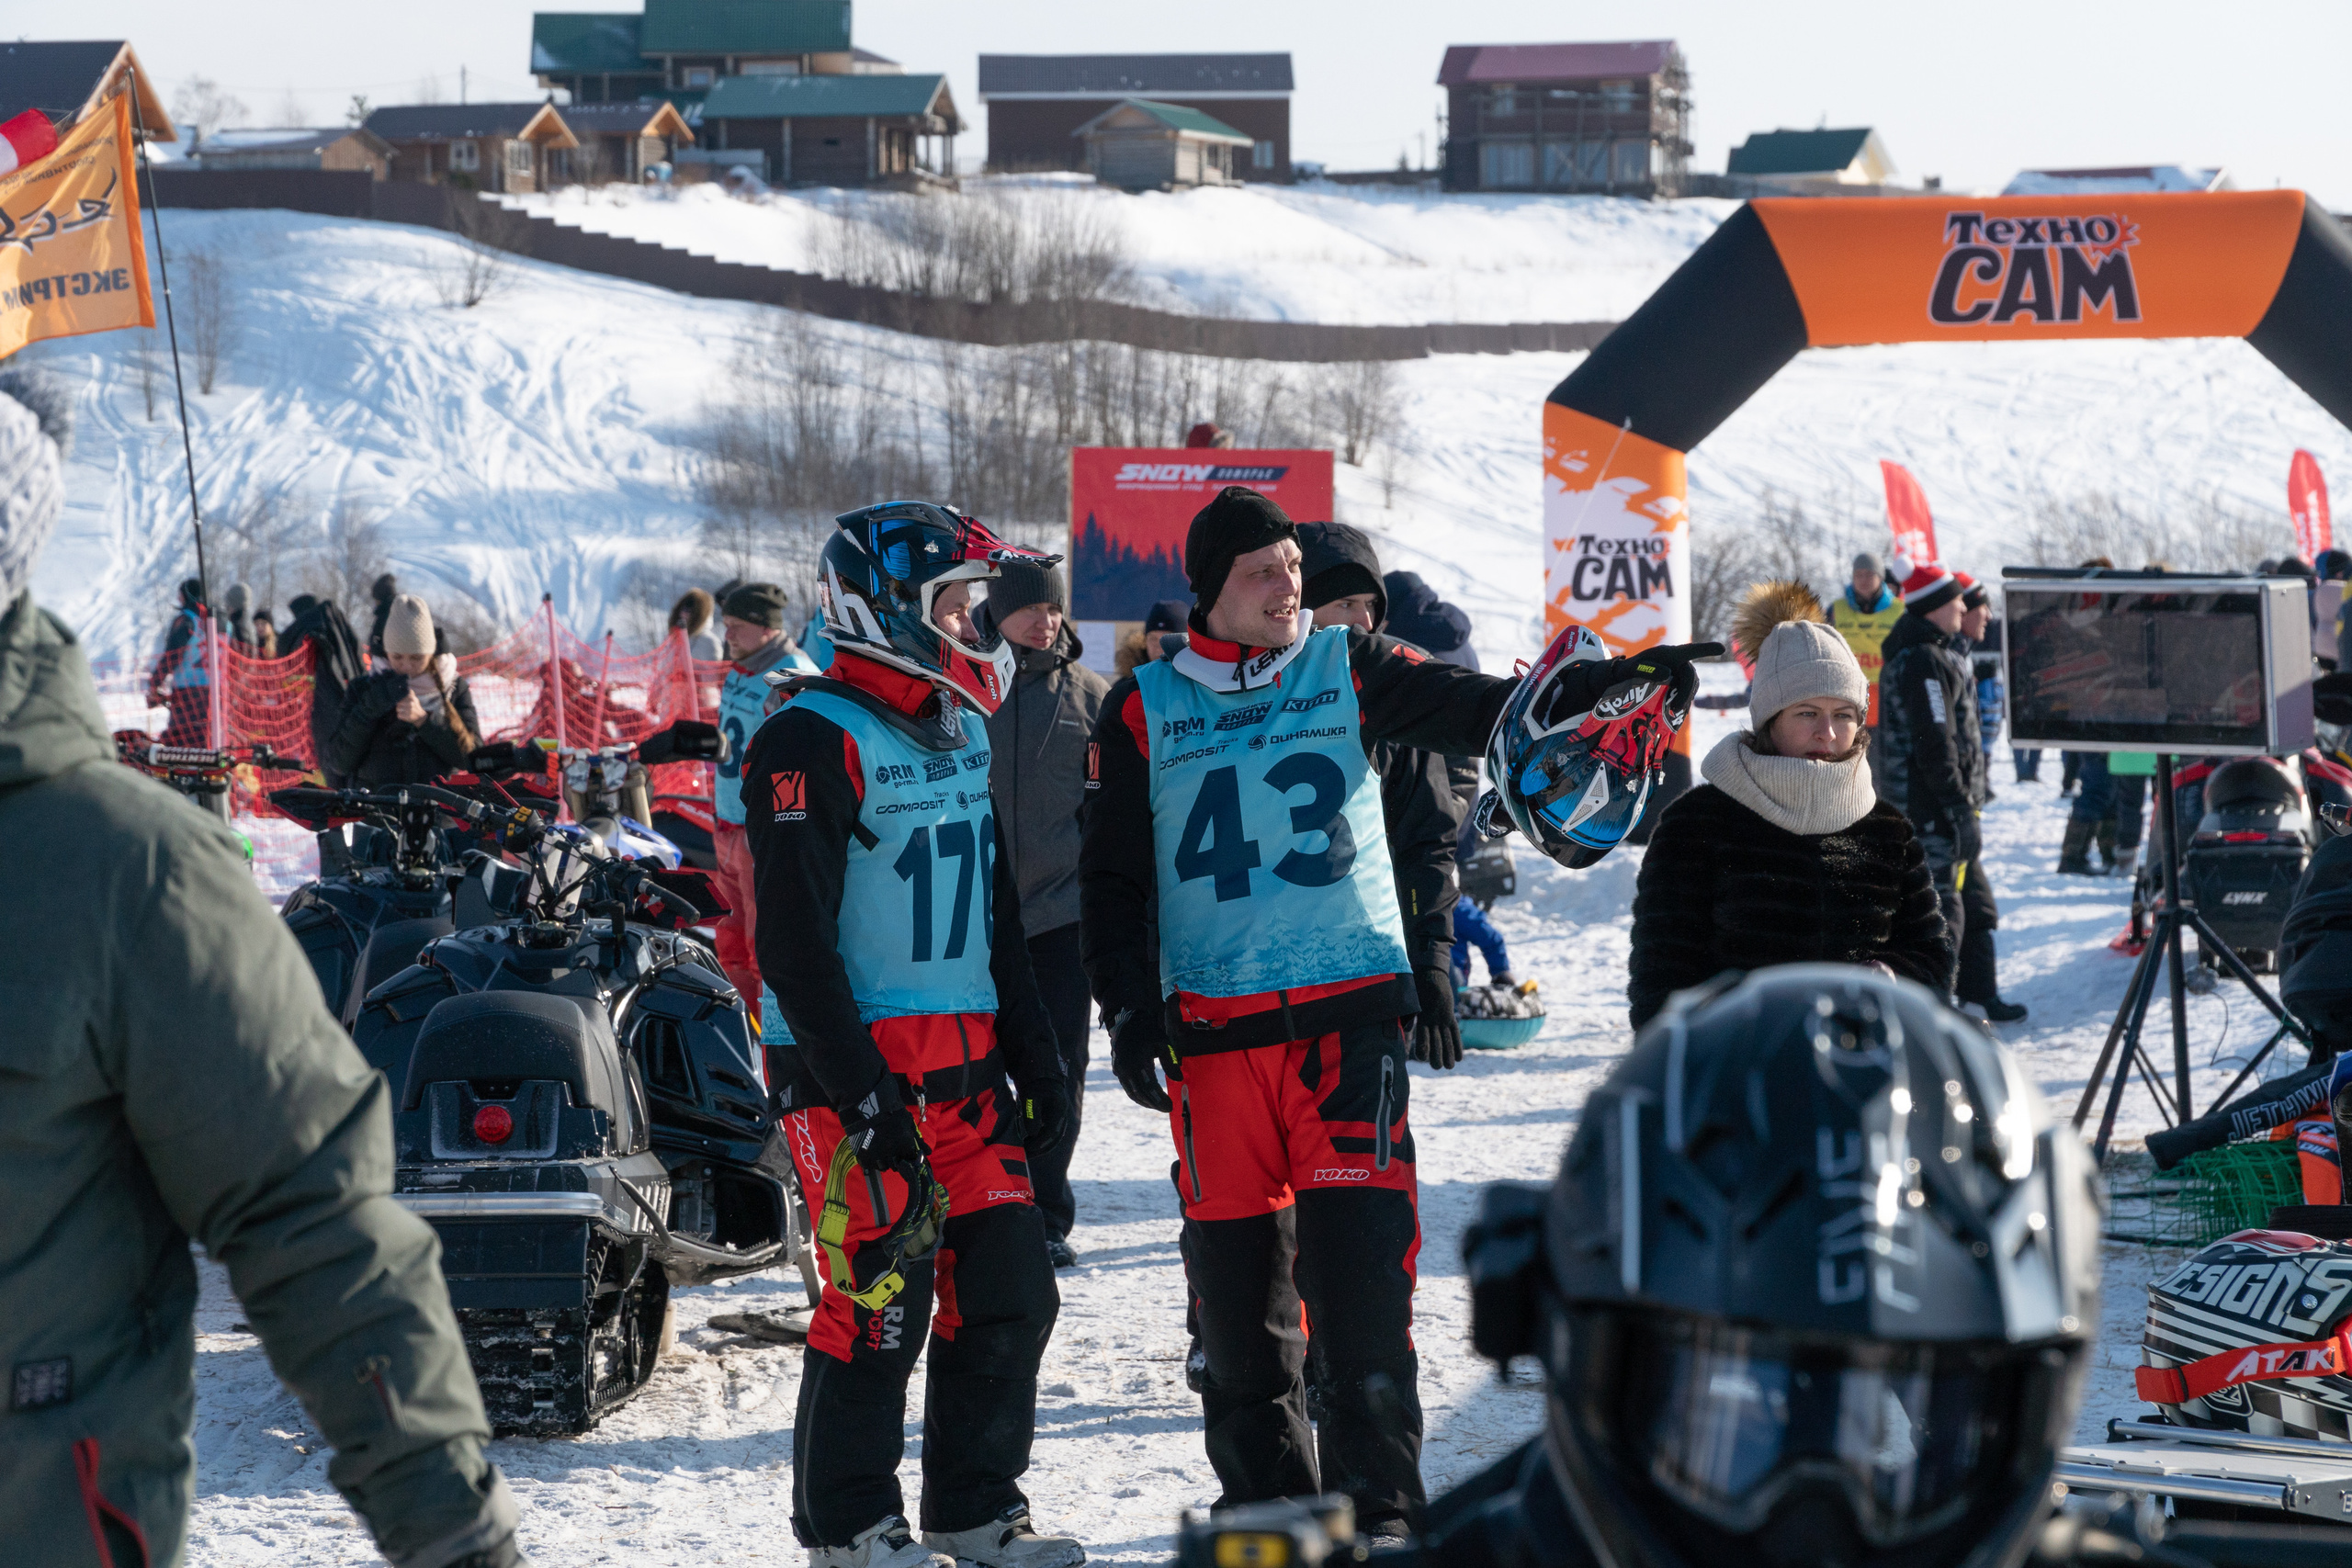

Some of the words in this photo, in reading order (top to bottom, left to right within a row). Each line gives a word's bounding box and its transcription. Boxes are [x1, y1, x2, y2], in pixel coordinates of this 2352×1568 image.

[1114, 463, 1216, 481] SNOW
[922, 661, 943, 673] AVIATOR
[1250, 642, 1294, 677] LEA
[987, 674, 998, 700] Airoh
[1599, 682, 1650, 716] Airoh
[1216, 704, 1274, 723] SNOW
[1172, 716, 1204, 735] RM
[1217, 737, 1238, 745] Tracks
[922, 755, 956, 773] SNOW
[1159, 744, 1230, 771] COMPOSIT
[888, 763, 916, 780] RM
[876, 799, 945, 814] COMPOSIT
[775, 812, 806, 822] YOKO
[1174, 751, 1358, 903] 43
[2222, 891, 2268, 906] LYNX
[862, 1127, 875, 1150] YOKO
[1313, 1168, 1370, 1182] YOKO
[865, 1309, 883, 1351] PORT
[880, 1306, 904, 1349] RM
